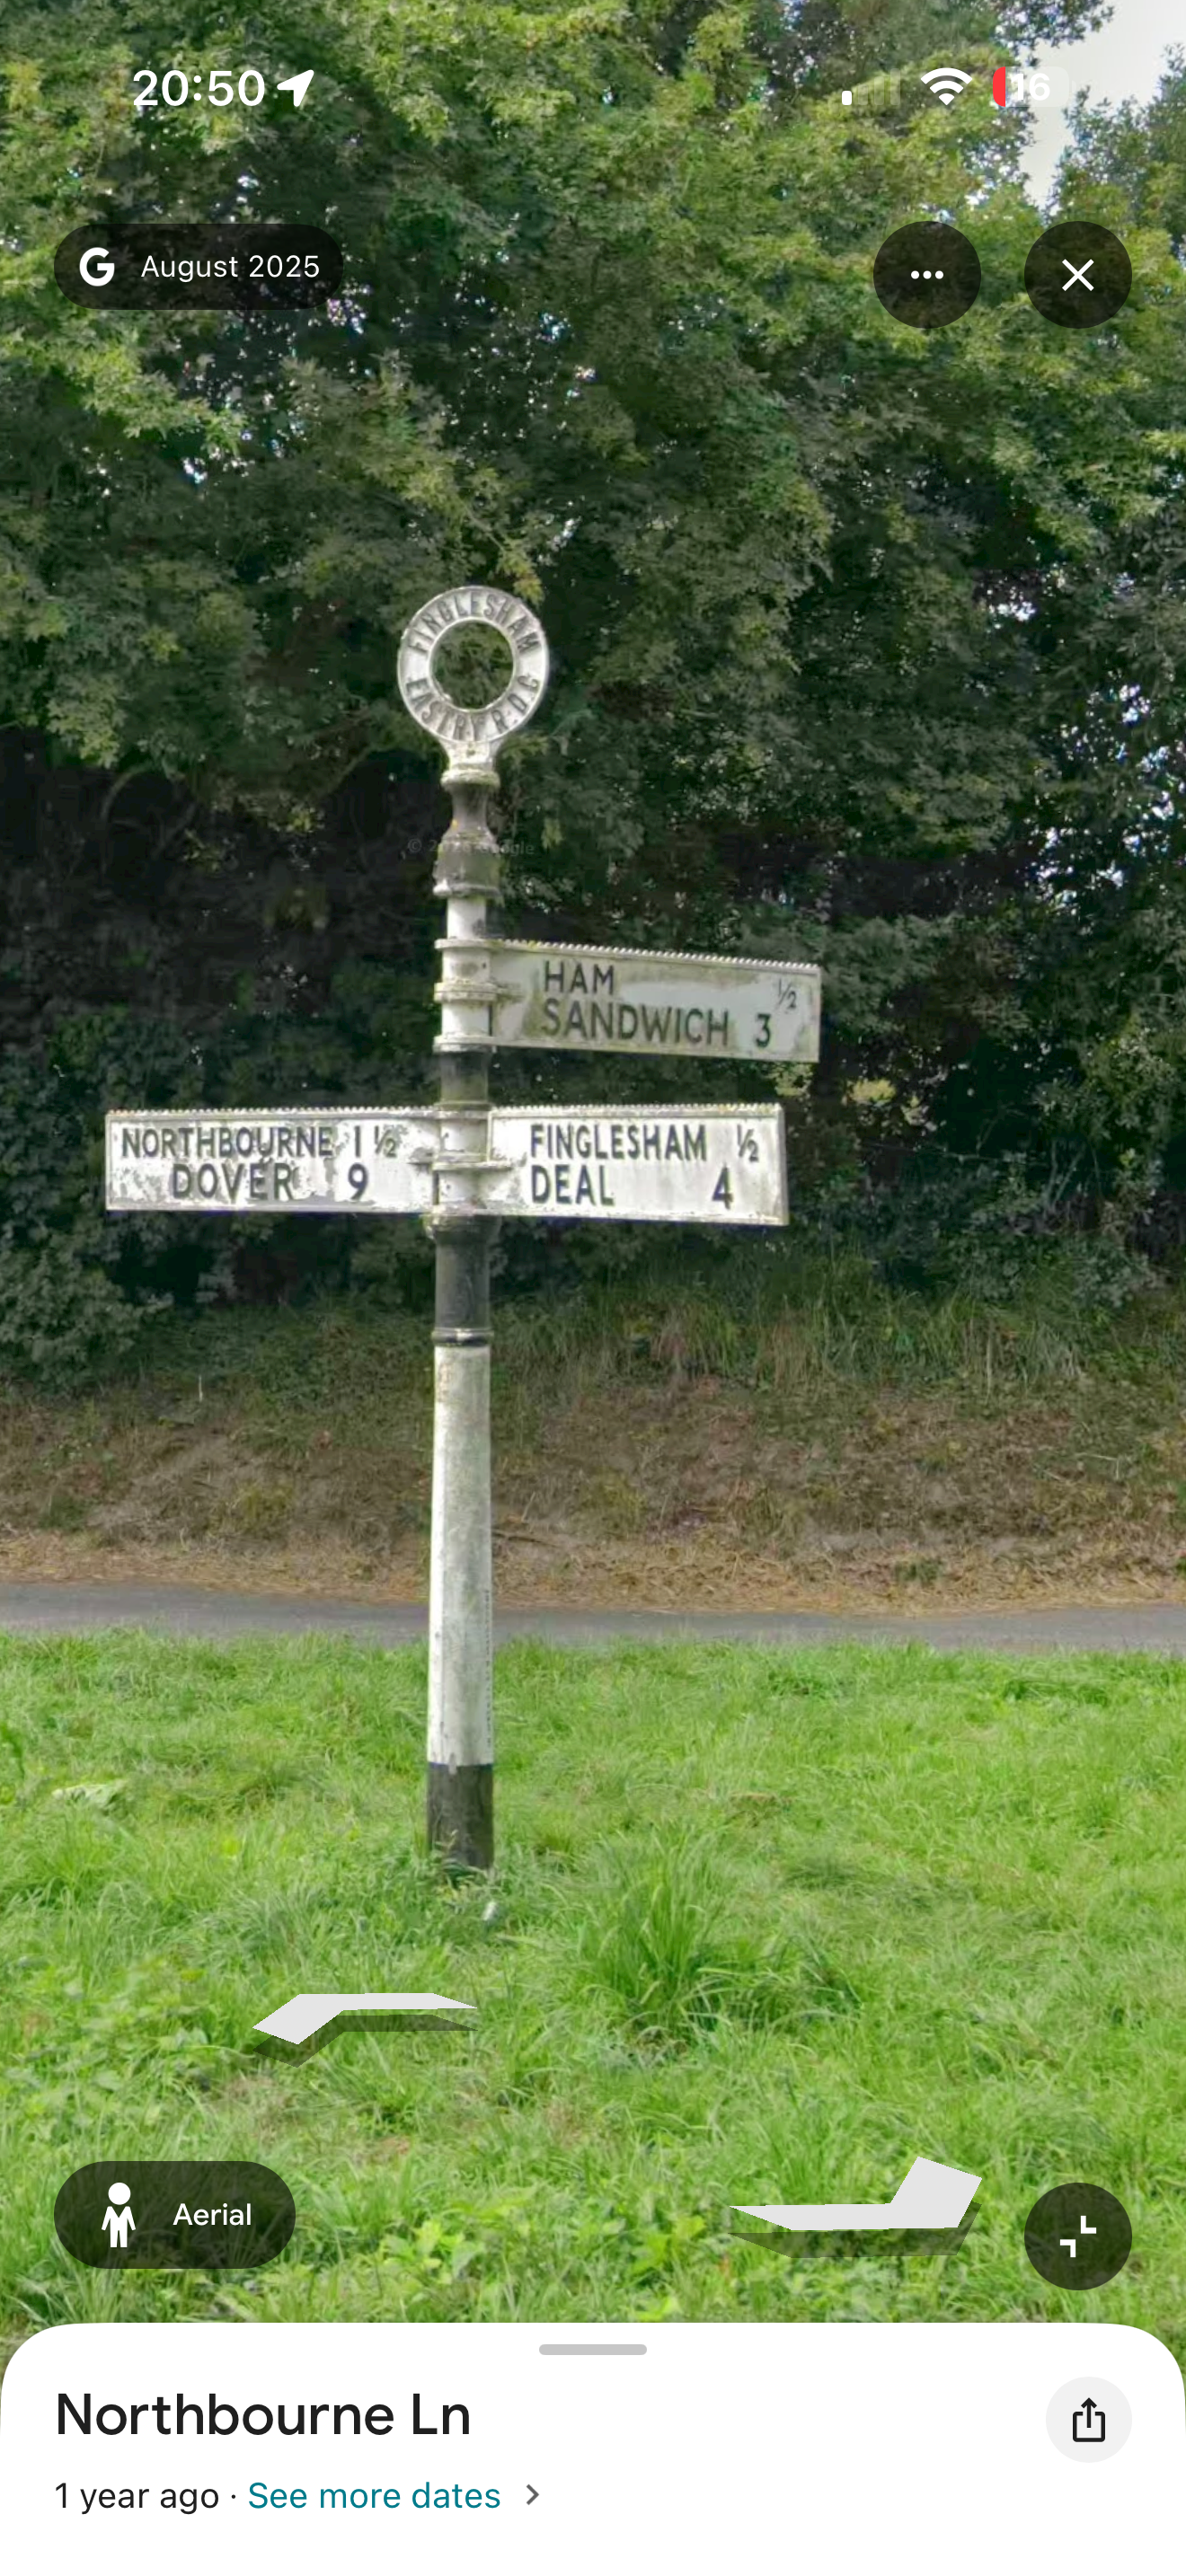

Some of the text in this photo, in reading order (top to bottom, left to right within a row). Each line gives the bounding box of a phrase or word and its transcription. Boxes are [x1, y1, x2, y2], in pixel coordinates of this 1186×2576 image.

[408, 591, 542, 655] FINGLESHAM
[406, 677, 486, 742] EASTRY
[544, 961, 615, 996] HAM
[541, 998, 772, 1048] SANDWICH 3
[122, 1126, 333, 1159] NORTHBOURNE
[530, 1124, 708, 1161] FINGLESHAM
[172, 1162, 369, 1202] DOVER 9
[531, 1164, 734, 1210] DEAL 4
